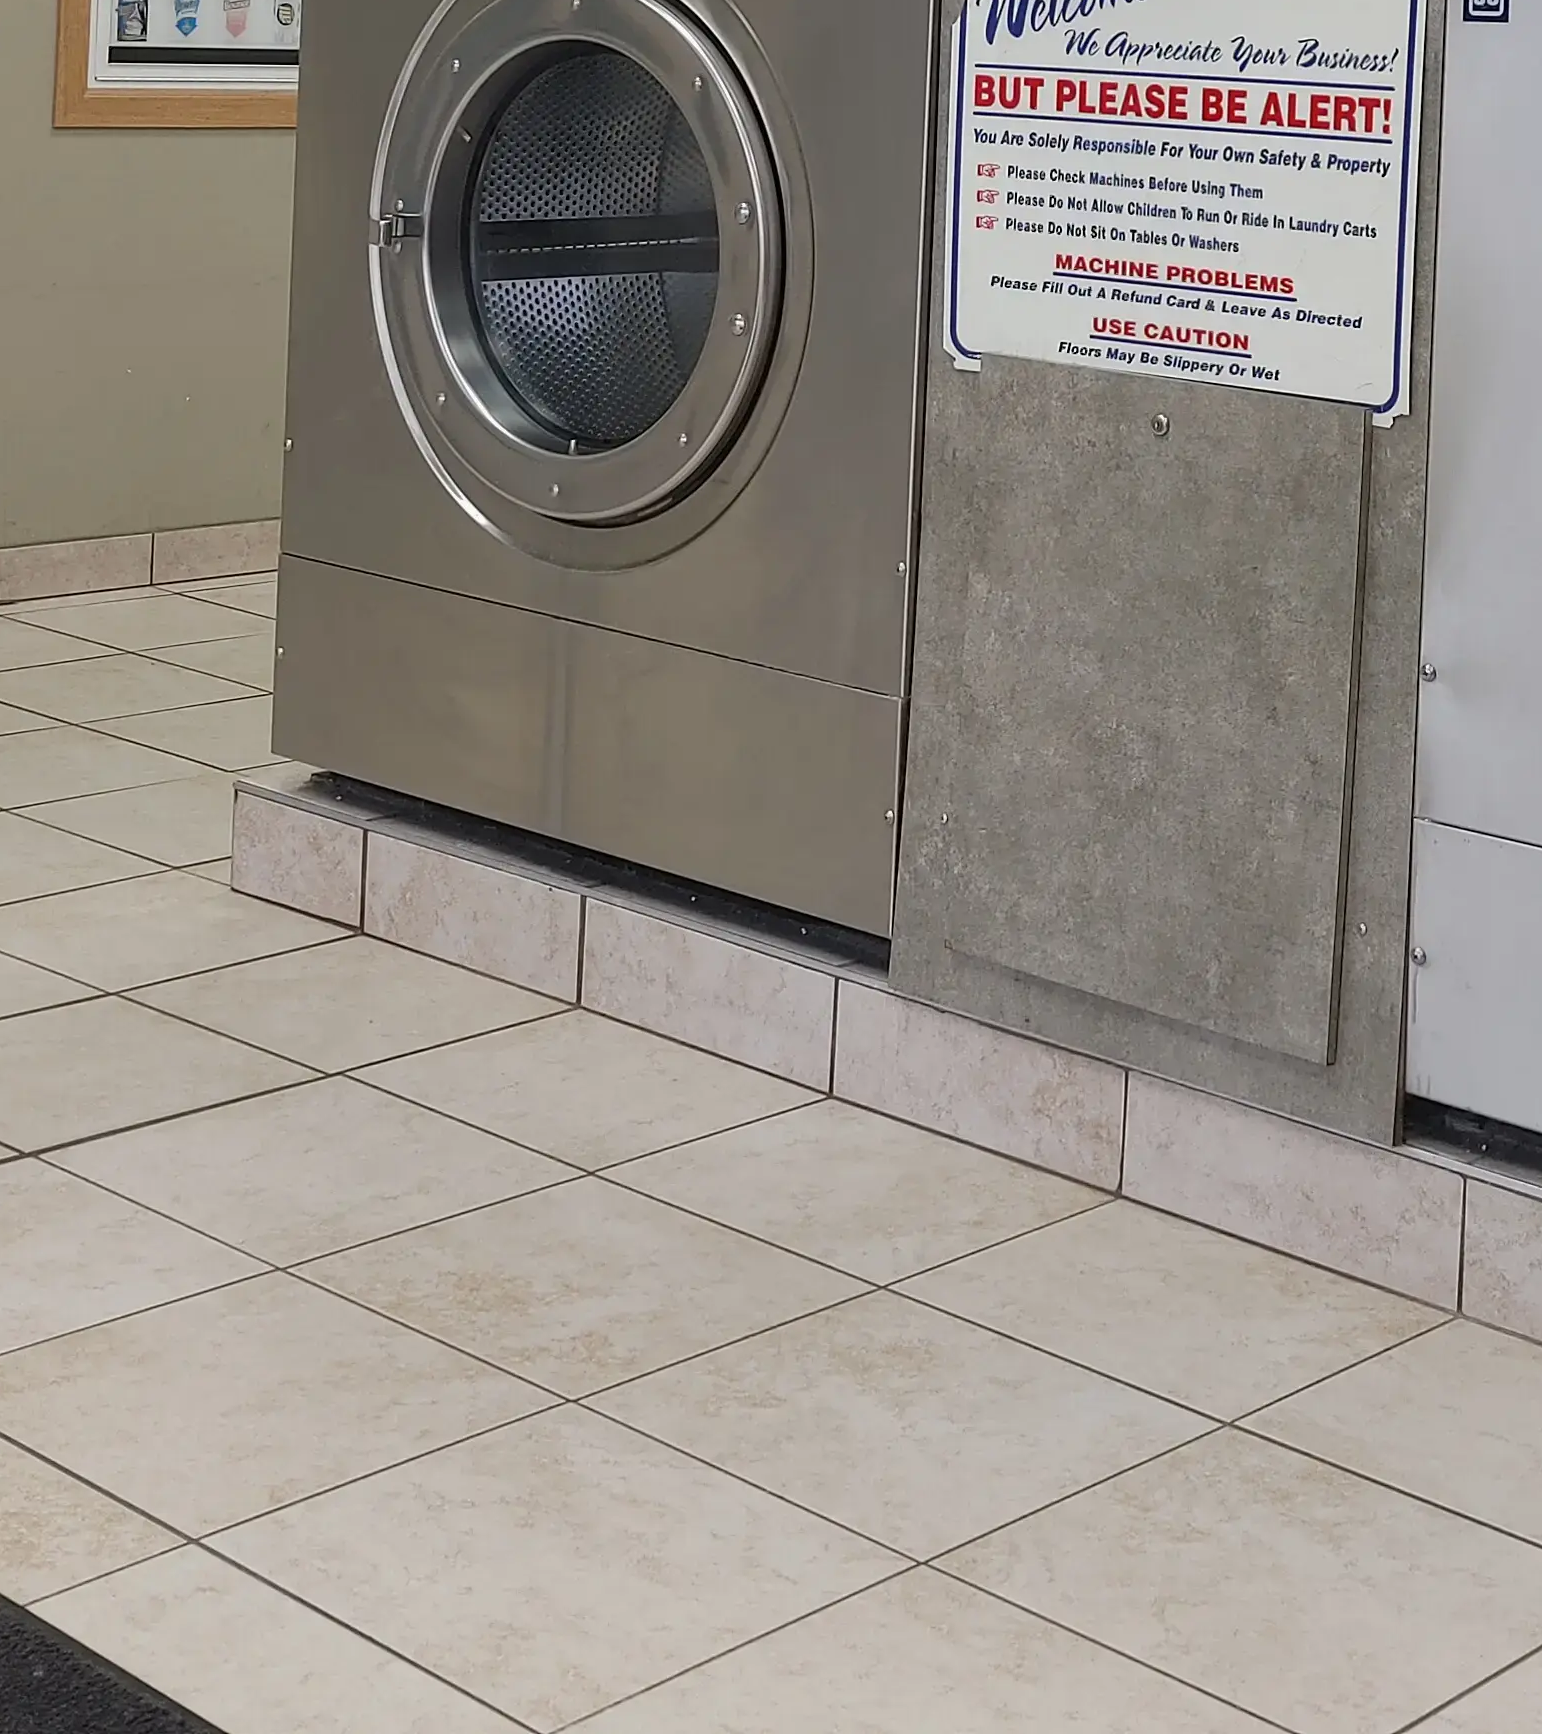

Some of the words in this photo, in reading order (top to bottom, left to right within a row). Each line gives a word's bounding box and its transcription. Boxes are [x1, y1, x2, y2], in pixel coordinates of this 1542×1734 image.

[1063, 28, 1100, 57] We
[1105, 31, 1222, 68] Appreciate
[1230, 36, 1291, 72] Your
[1294, 38, 1400, 73] Business!
[975, 75, 1044, 110] BUT
[1056, 79, 1188, 120] PLEASE
[1202, 88, 1247, 124] BE
[1260, 92, 1391, 134] ALERT!
[974, 129, 996, 144] You
[1001, 130, 1023, 146] Are
[1028, 132, 1069, 152] Solely
[1073, 135, 1156, 155] Responsible
[1160, 142, 1183, 157] For
[1189, 144, 1218, 160] Your
[1223, 146, 1254, 163] Own
[1259, 149, 1306, 170] Safety
[1311, 153, 1321, 168] &
[1327, 154, 1390, 177] Property
[1008, 165, 1045, 180] Please
[1050, 169, 1085, 183] Check
[1090, 172, 1144, 189] Machines
[1149, 177, 1187, 192] Before
[1192, 180, 1225, 198] Using
[1230, 183, 1263, 199] Them
[1006, 218, 1043, 233] Please
[1048, 222, 1062, 235] Do
[1067, 223, 1086, 237] Not
[1091, 226, 1105, 239] Sit
[1110, 228, 1125, 241] On
[1130, 229, 1167, 245] Tables
[1172, 233, 1185, 247] Or
[1189, 235, 1239, 252] Washers
[1007, 192, 1044, 207] Please
[1049, 195, 1063, 208] Do
[1068, 197, 1087, 211] Not
[1091, 199, 1123, 214] Allow
[1128, 202, 1176, 218] Children
[1181, 207, 1193, 220] To
[1197, 208, 1219, 223] Run
[1224, 211, 1237, 224] Or
[1242, 213, 1268, 227] Ride
[1273, 215, 1284, 229] In
[1289, 217, 1339, 237] Laundry
[1343, 222, 1376, 238] Carts
[1056, 254, 1157, 279] MACHINE
[1167, 266, 1293, 294] PROBLEMS
[991, 276, 1037, 291] Please
[1042, 281, 1063, 294] Fill
[1068, 284, 1092, 296] Out
[1096, 287, 1105, 299] A
[1111, 289, 1162, 305] Refund
[1167, 295, 1201, 309] Card
[1205, 300, 1215, 311] &
[1222, 301, 1266, 317] Leave
[1271, 307, 1290, 320] As
[1296, 310, 1362, 328] Directed
[1093, 318, 1135, 336] USE
[1144, 324, 1248, 350] CAUTION
[1059, 342, 1101, 357] Floors
[1106, 348, 1135, 364] May
[1140, 352, 1158, 364] Be
[1164, 355, 1224, 375] Slippery
[1229, 364, 1247, 376] Or
[1252, 366, 1279, 380] Wet
